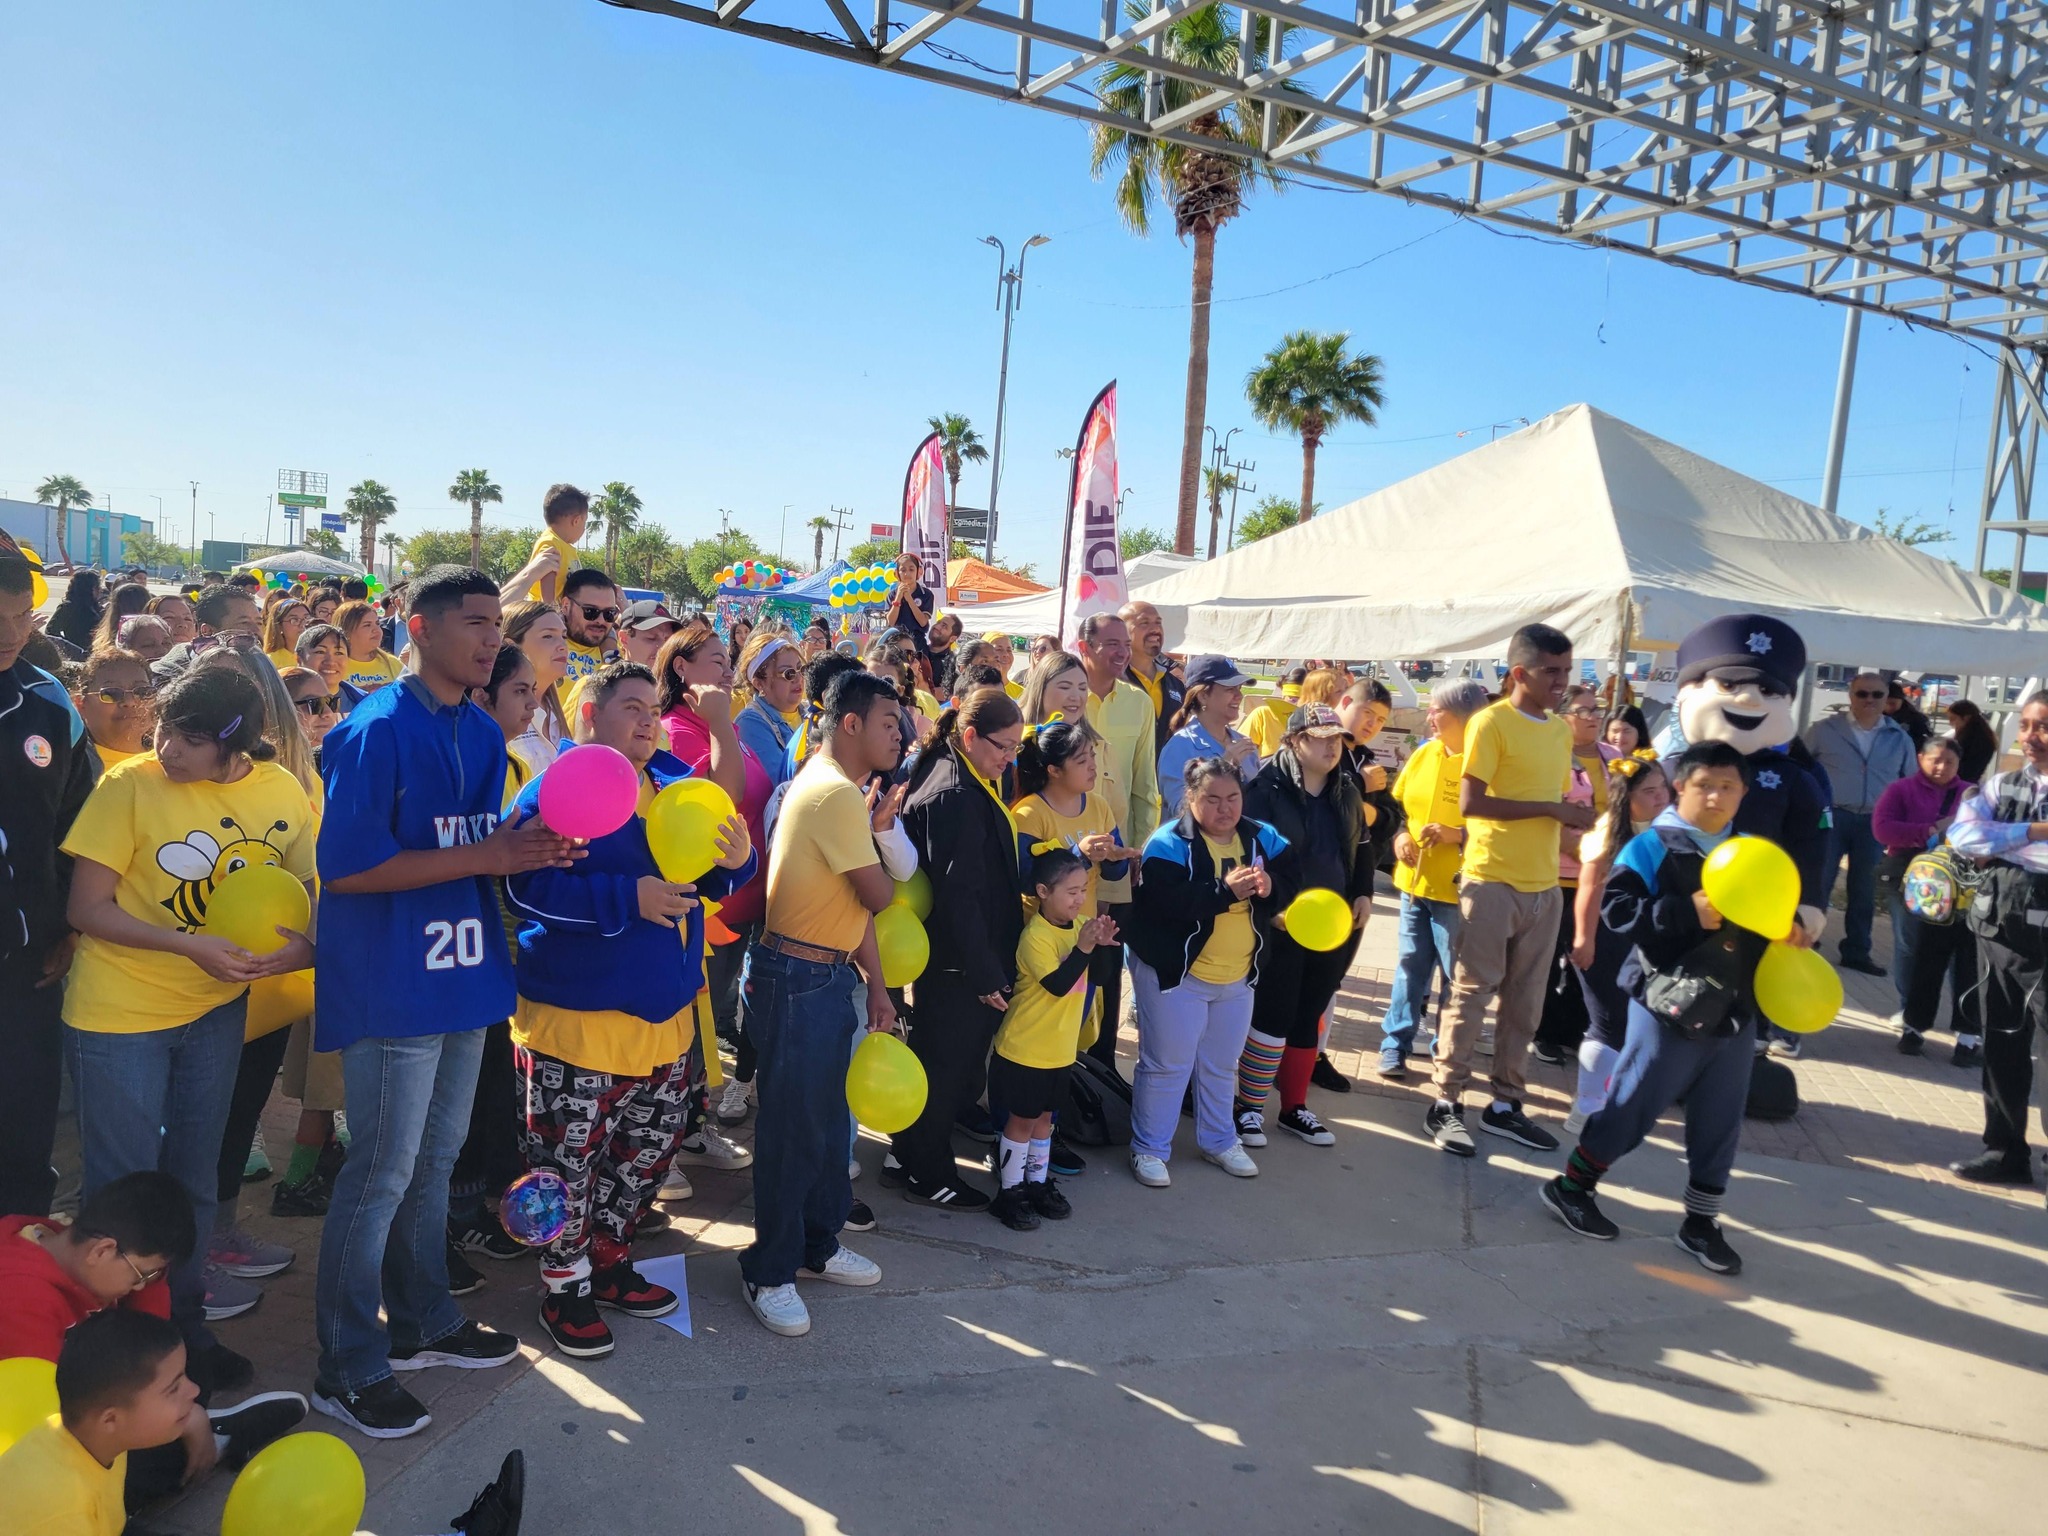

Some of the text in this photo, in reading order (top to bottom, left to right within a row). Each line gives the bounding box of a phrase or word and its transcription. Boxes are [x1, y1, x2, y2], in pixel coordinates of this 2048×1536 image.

[918, 528, 941, 588] DIF
[1085, 500, 1118, 576] DIF
[350, 673, 382, 683] Mamá
[424, 917, 485, 971] 20
